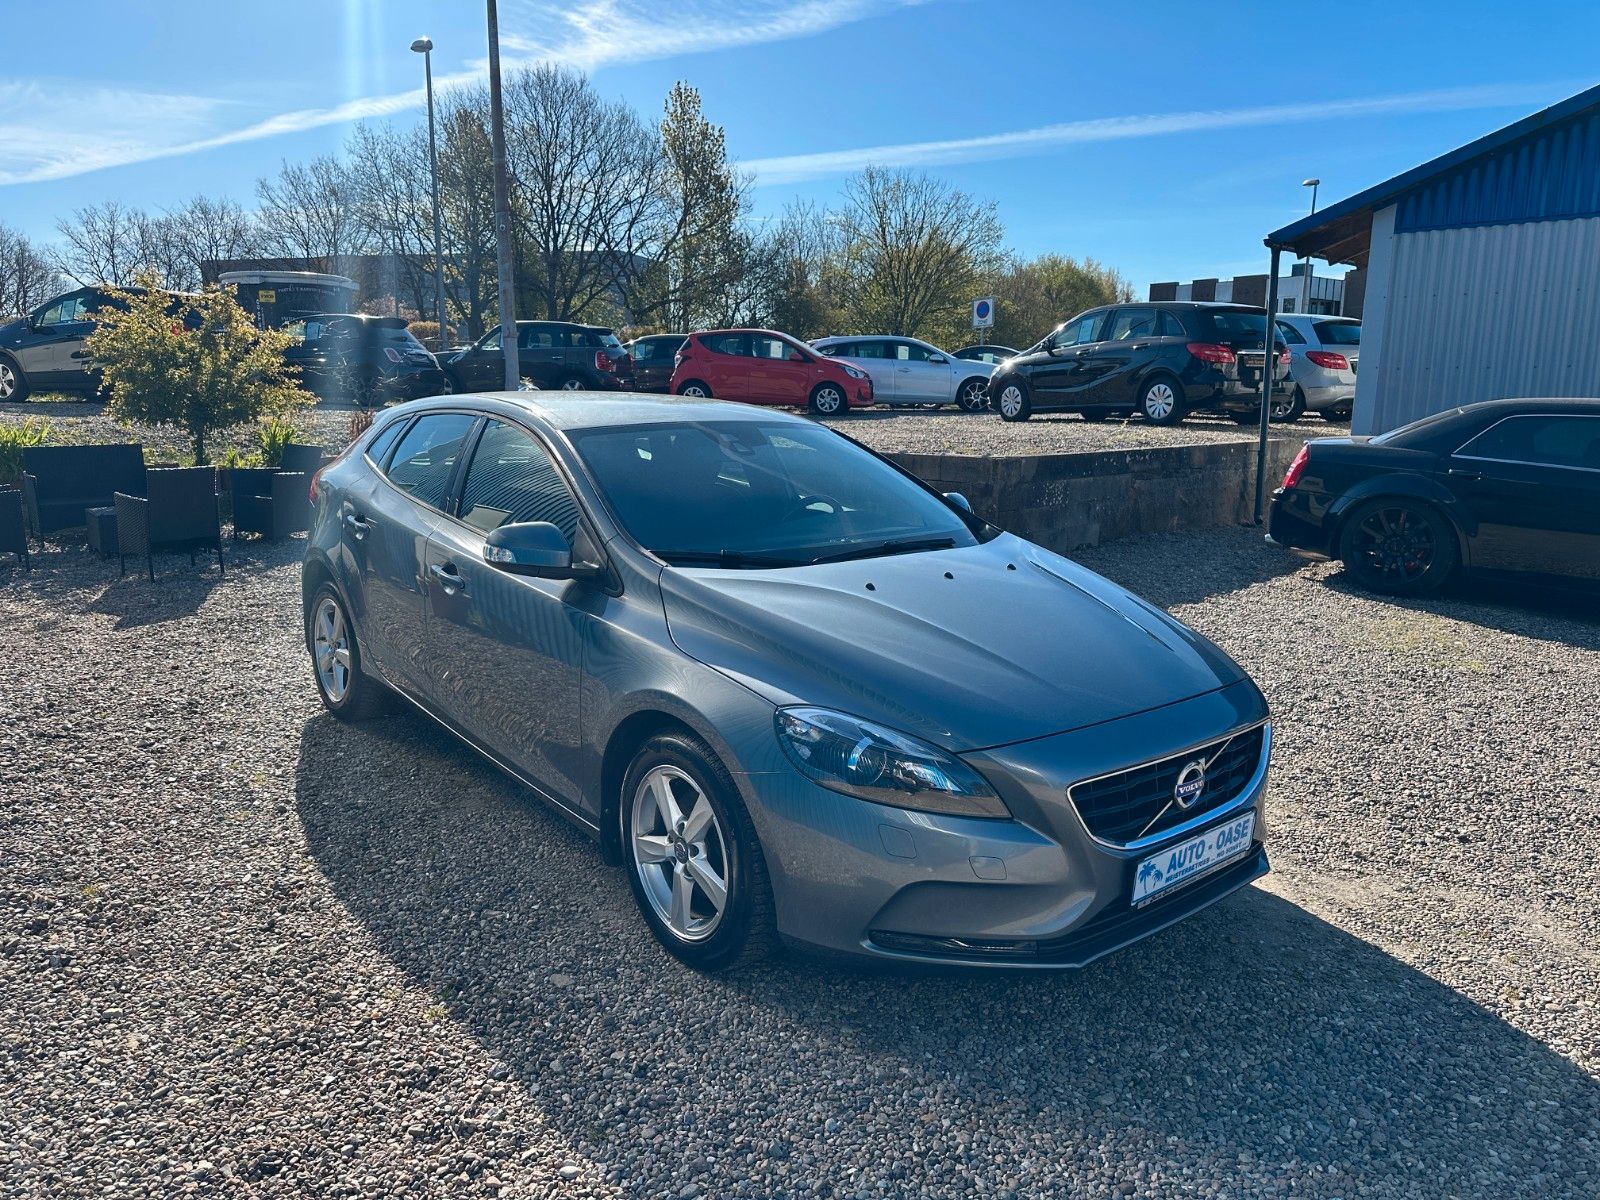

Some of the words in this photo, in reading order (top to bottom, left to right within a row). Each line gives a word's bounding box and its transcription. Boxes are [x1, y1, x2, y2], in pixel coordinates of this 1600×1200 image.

[1178, 779, 1204, 794] VOLVO
[1166, 839, 1206, 874] AUTO
[1216, 818, 1250, 850] OASE
